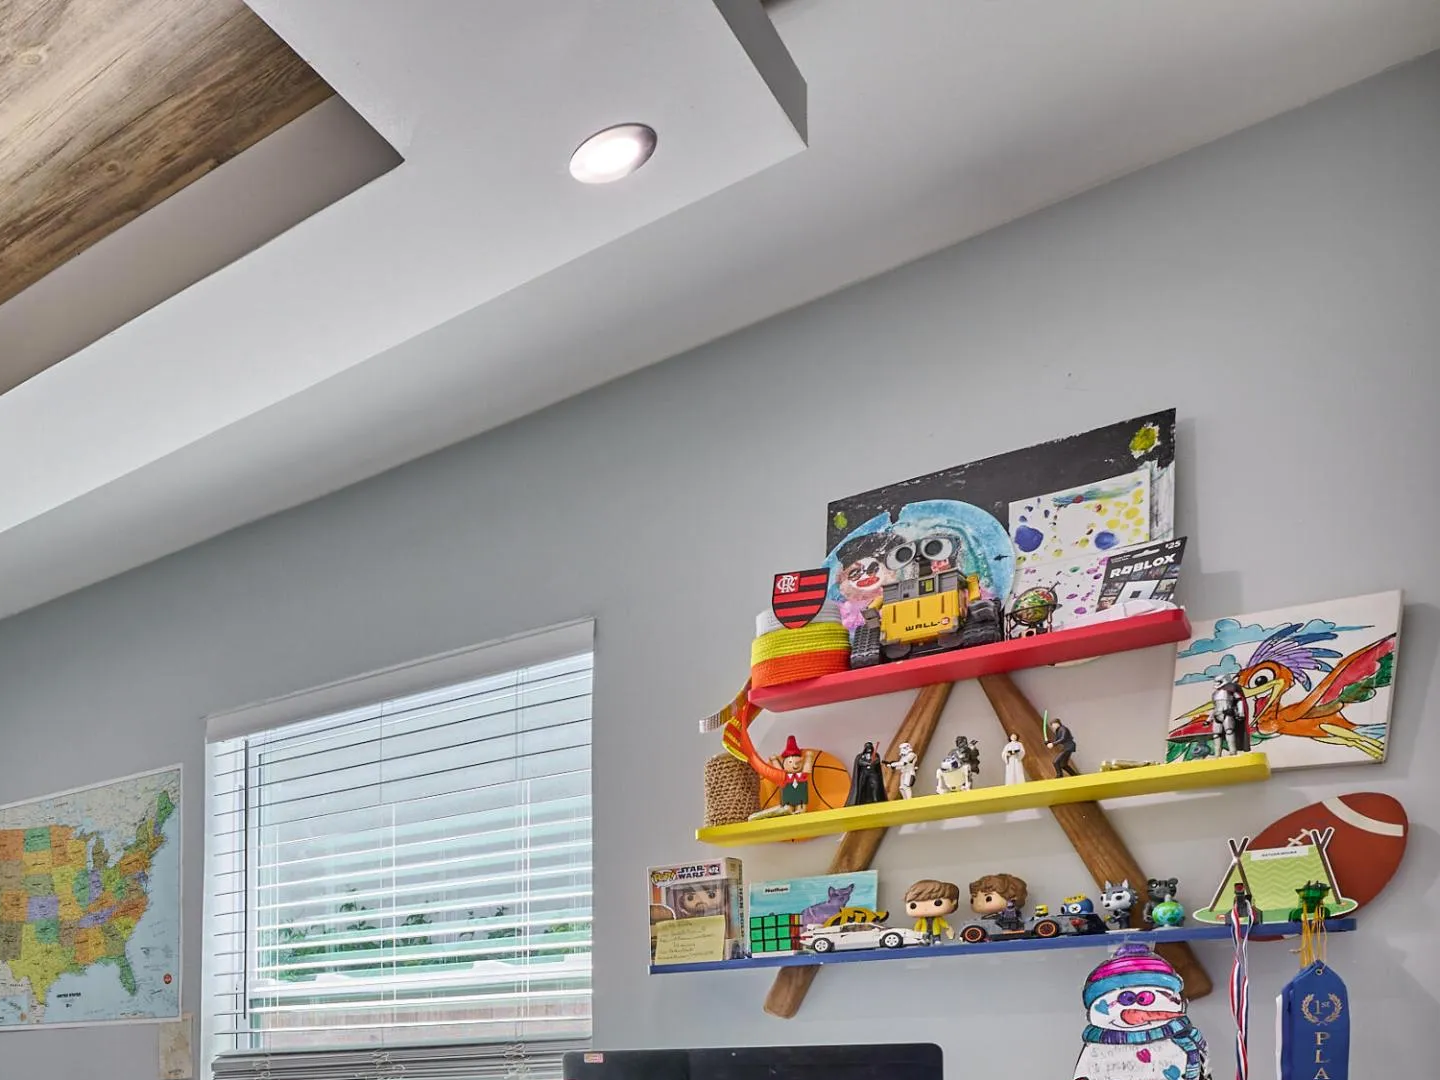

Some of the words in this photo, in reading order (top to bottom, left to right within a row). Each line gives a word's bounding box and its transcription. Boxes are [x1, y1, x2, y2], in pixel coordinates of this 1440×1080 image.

[1109, 553, 1177, 579] ROBLOX
[678, 864, 705, 874] STAR
[678, 871, 705, 880] WARS
[1314, 999, 1331, 1015] 1st
